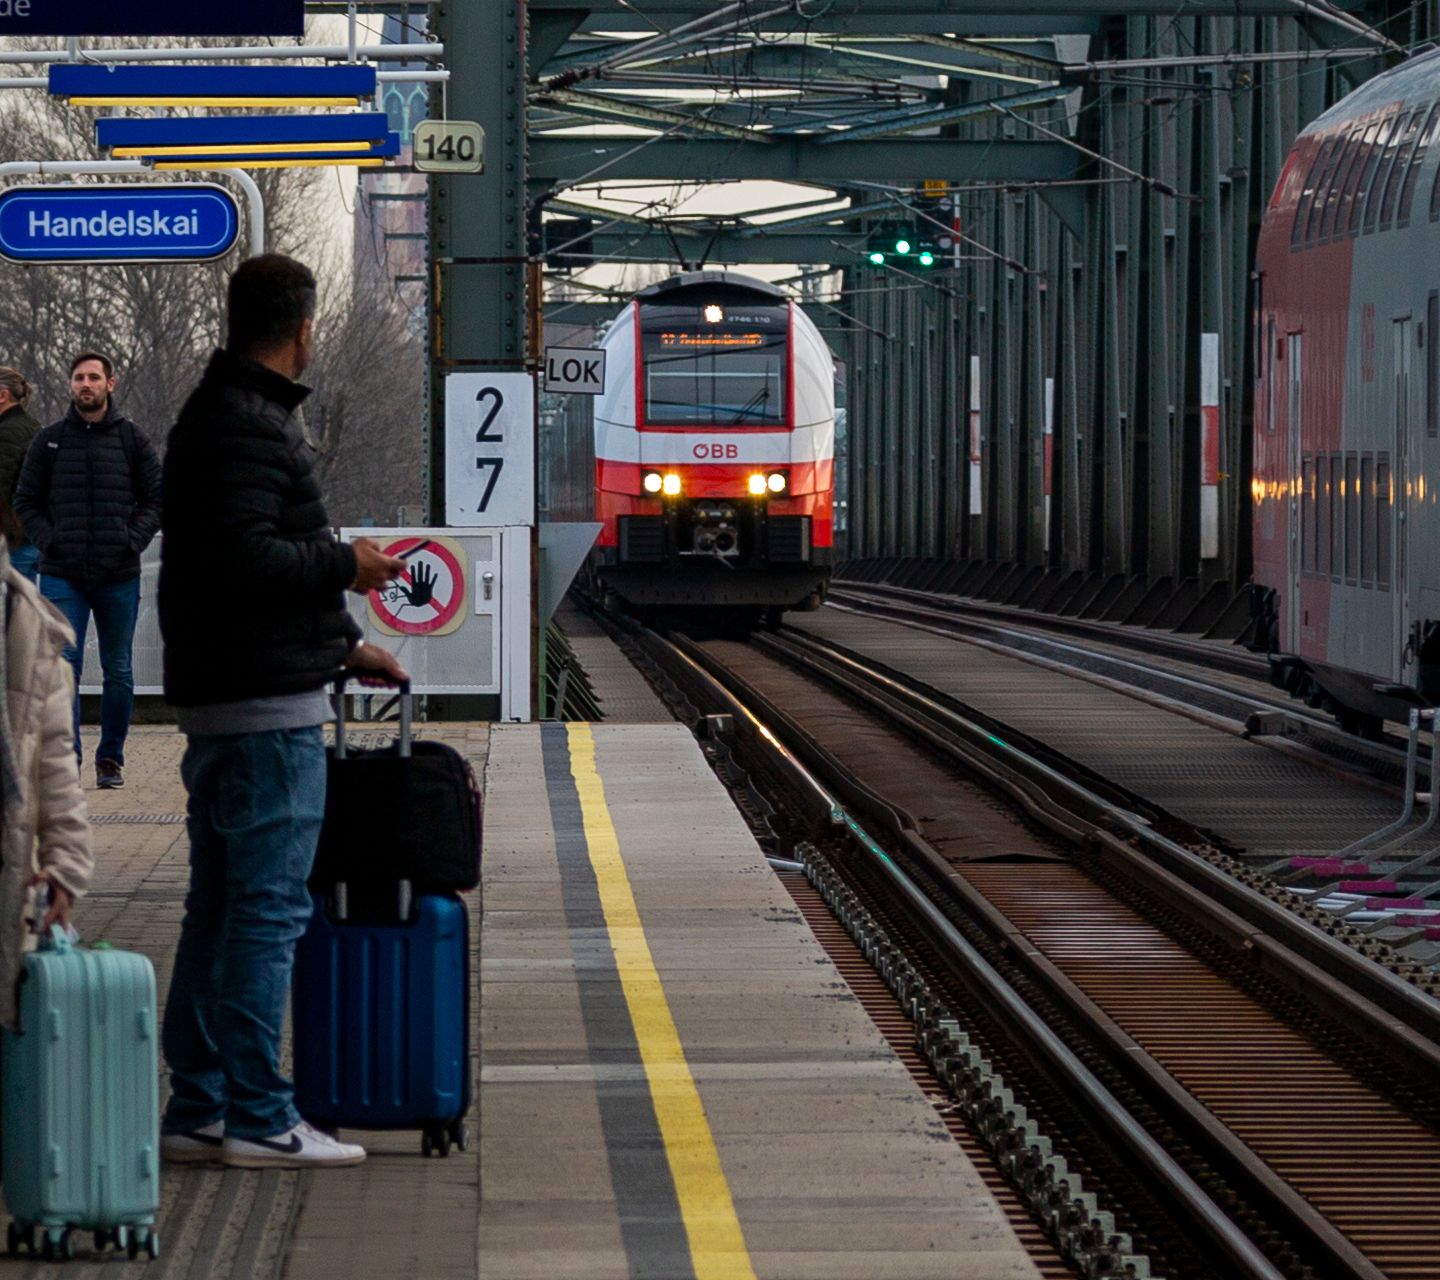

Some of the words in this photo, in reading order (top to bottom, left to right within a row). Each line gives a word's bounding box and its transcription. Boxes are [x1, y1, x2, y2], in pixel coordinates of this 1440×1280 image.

[423, 134, 475, 161] 140
[27, 207, 199, 241] Handelskai
[548, 358, 600, 383] LOK
[475, 387, 503, 443] 2
[693, 443, 738, 459] ÖBB
[475, 458, 503, 513] 7
